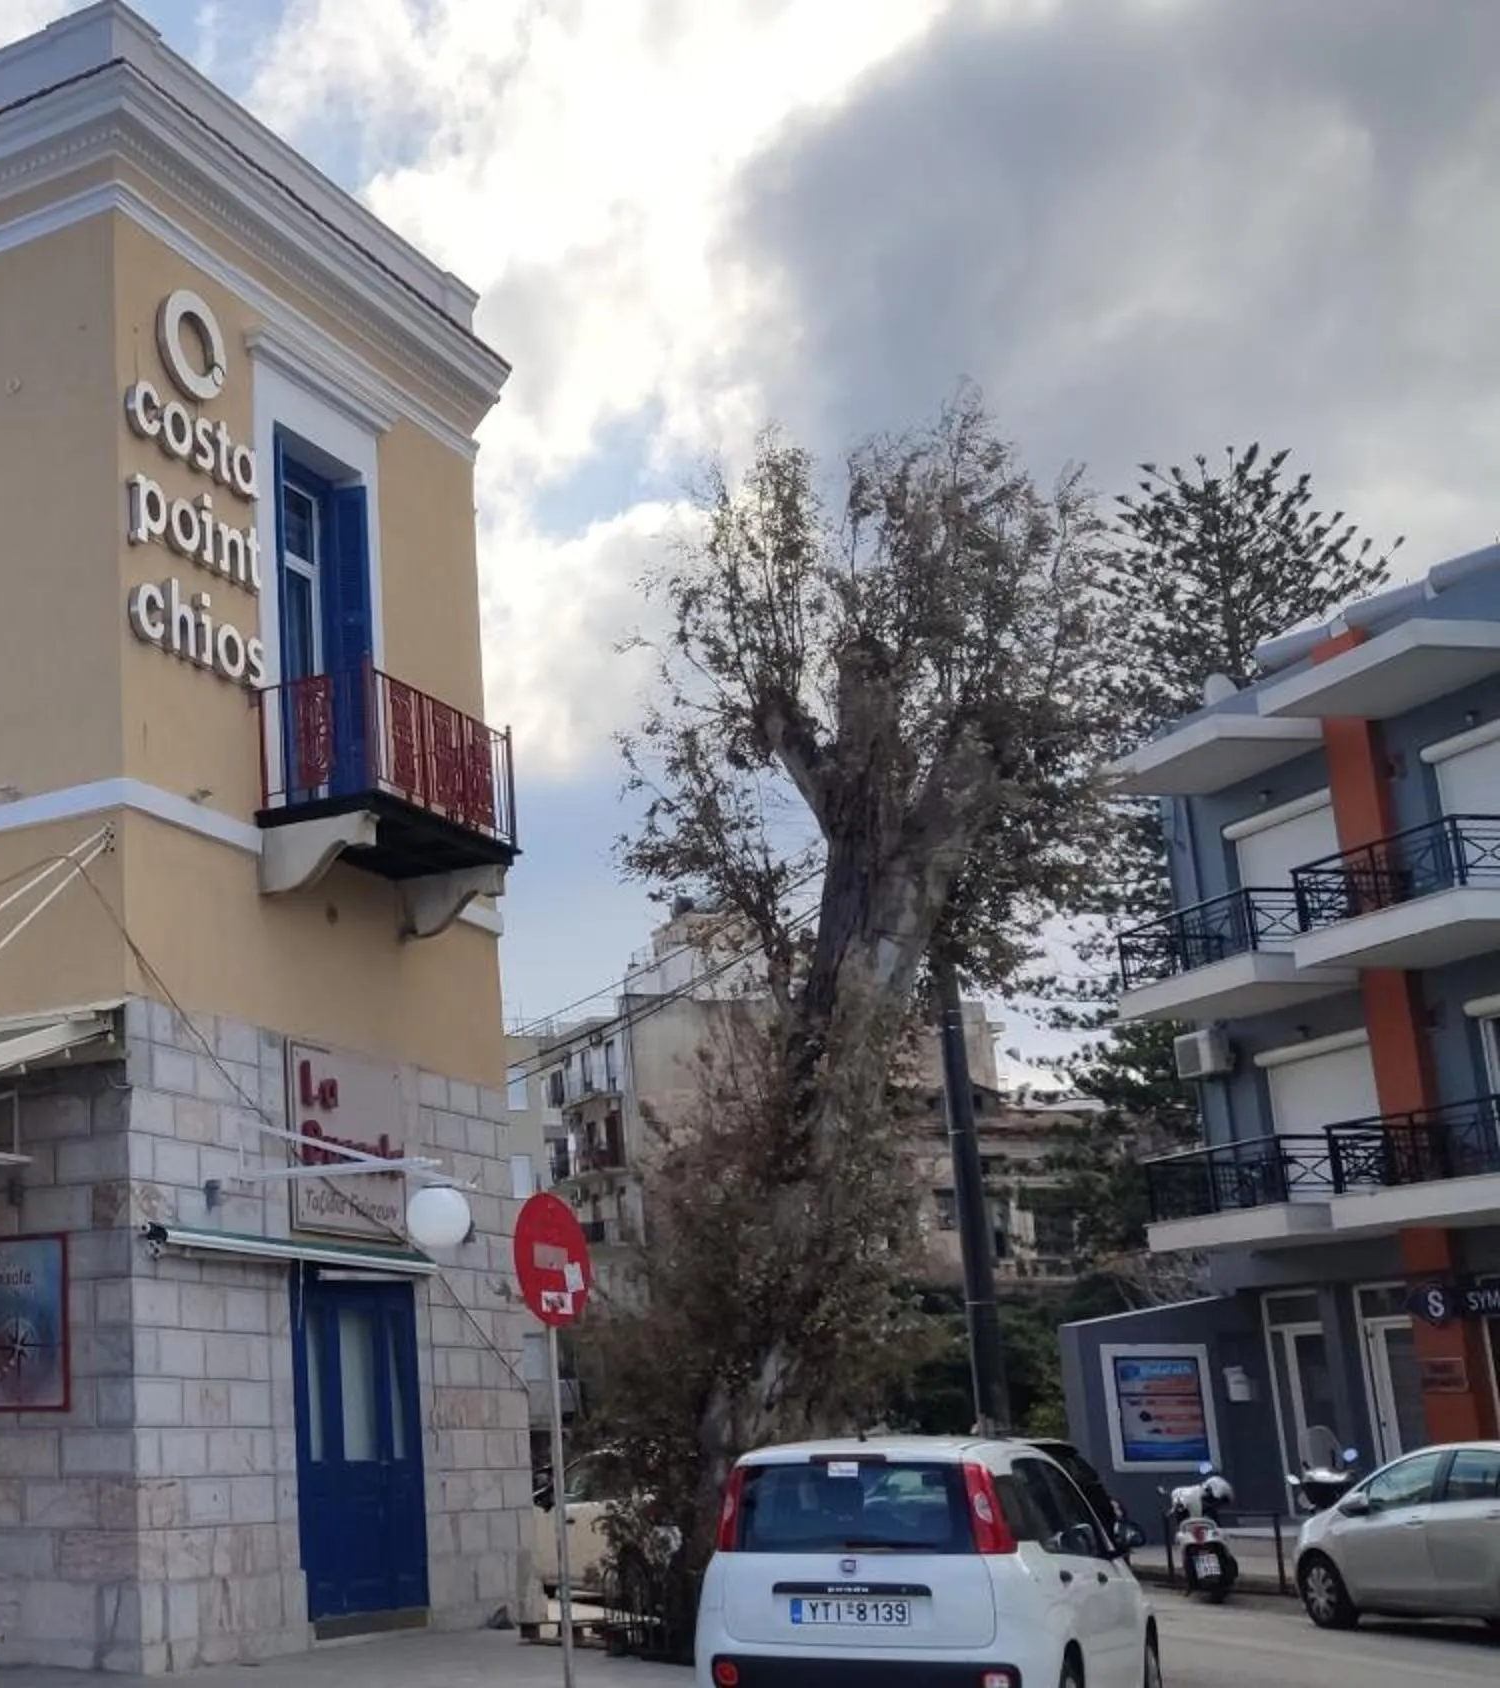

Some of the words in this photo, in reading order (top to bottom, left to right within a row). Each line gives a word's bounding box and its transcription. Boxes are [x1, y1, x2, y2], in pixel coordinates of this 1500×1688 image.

[127, 380, 261, 499] costa
[128, 473, 262, 591] point
[129, 577, 267, 689] chios
[299, 1060, 338, 1109] La
